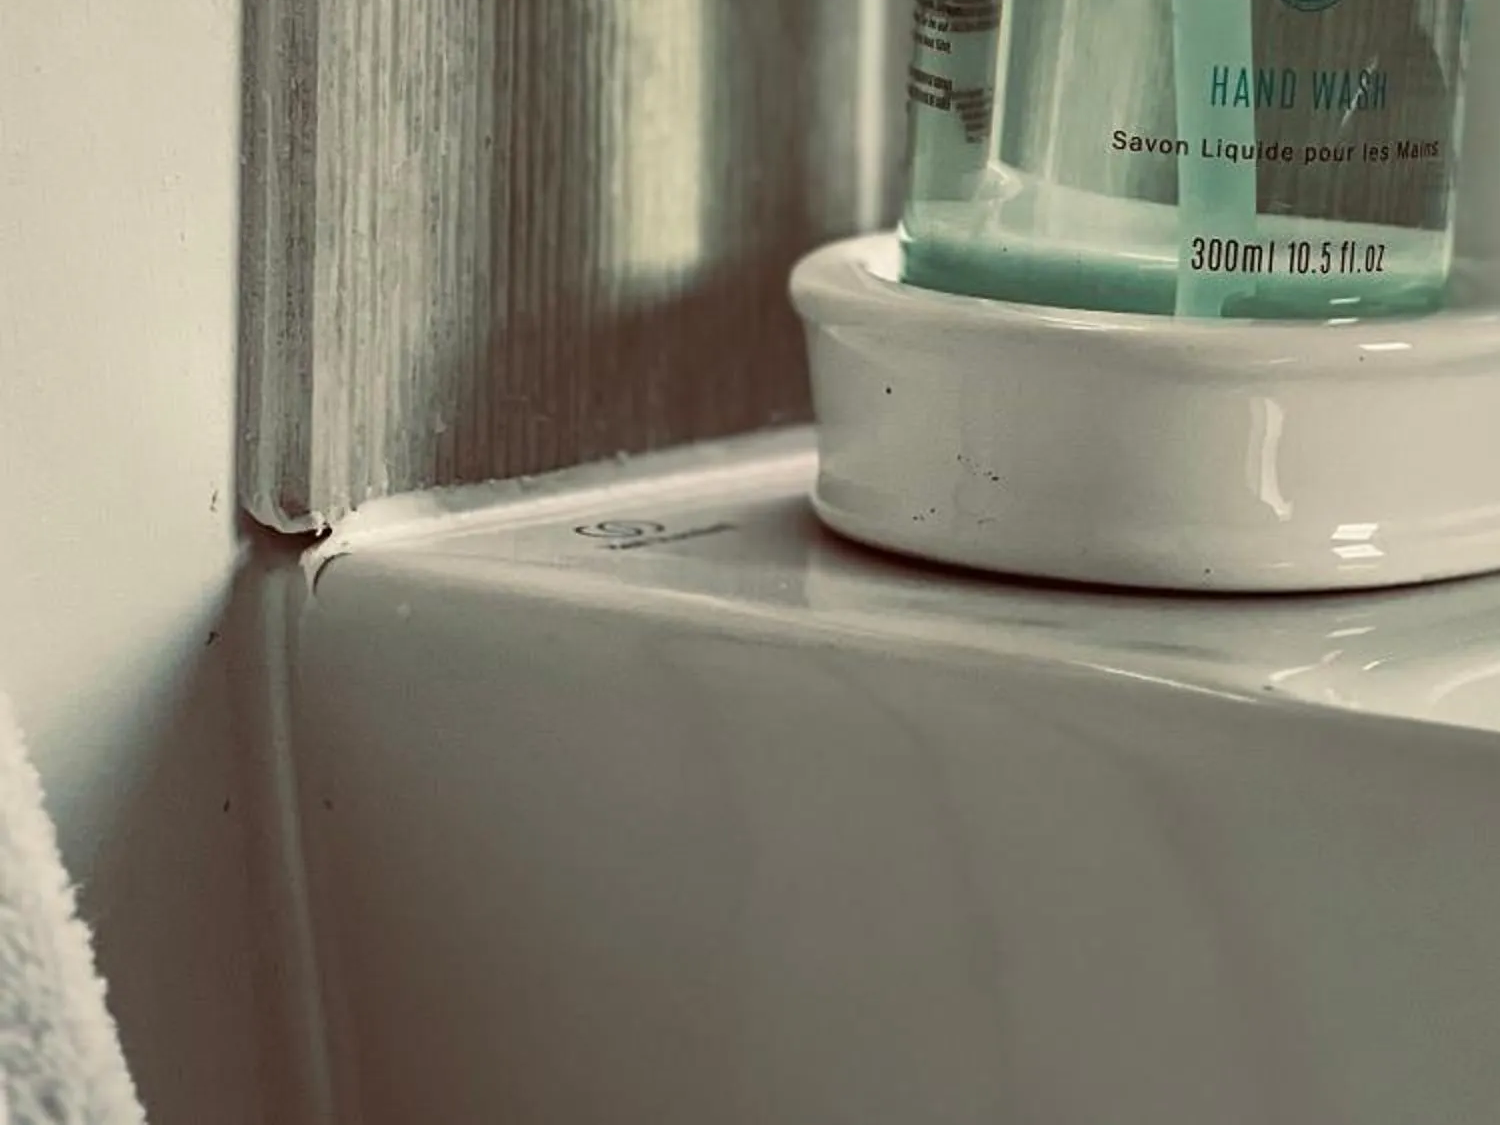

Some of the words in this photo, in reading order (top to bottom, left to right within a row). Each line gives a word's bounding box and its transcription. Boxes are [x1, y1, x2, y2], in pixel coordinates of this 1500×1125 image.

[1210, 65, 1296, 109] HAND
[1312, 68, 1387, 111] WASH
[1111, 130, 1189, 155] Savon
[1201, 138, 1293, 164] Liquide
[1304, 142, 1355, 165] pour
[1362, 141, 1390, 162] les
[1397, 140, 1440, 161] Mains
[1191, 237, 1275, 274] 300ml
[1287, 241, 1332, 275] 10.5
[1340, 240, 1386, 274] fl.oz
